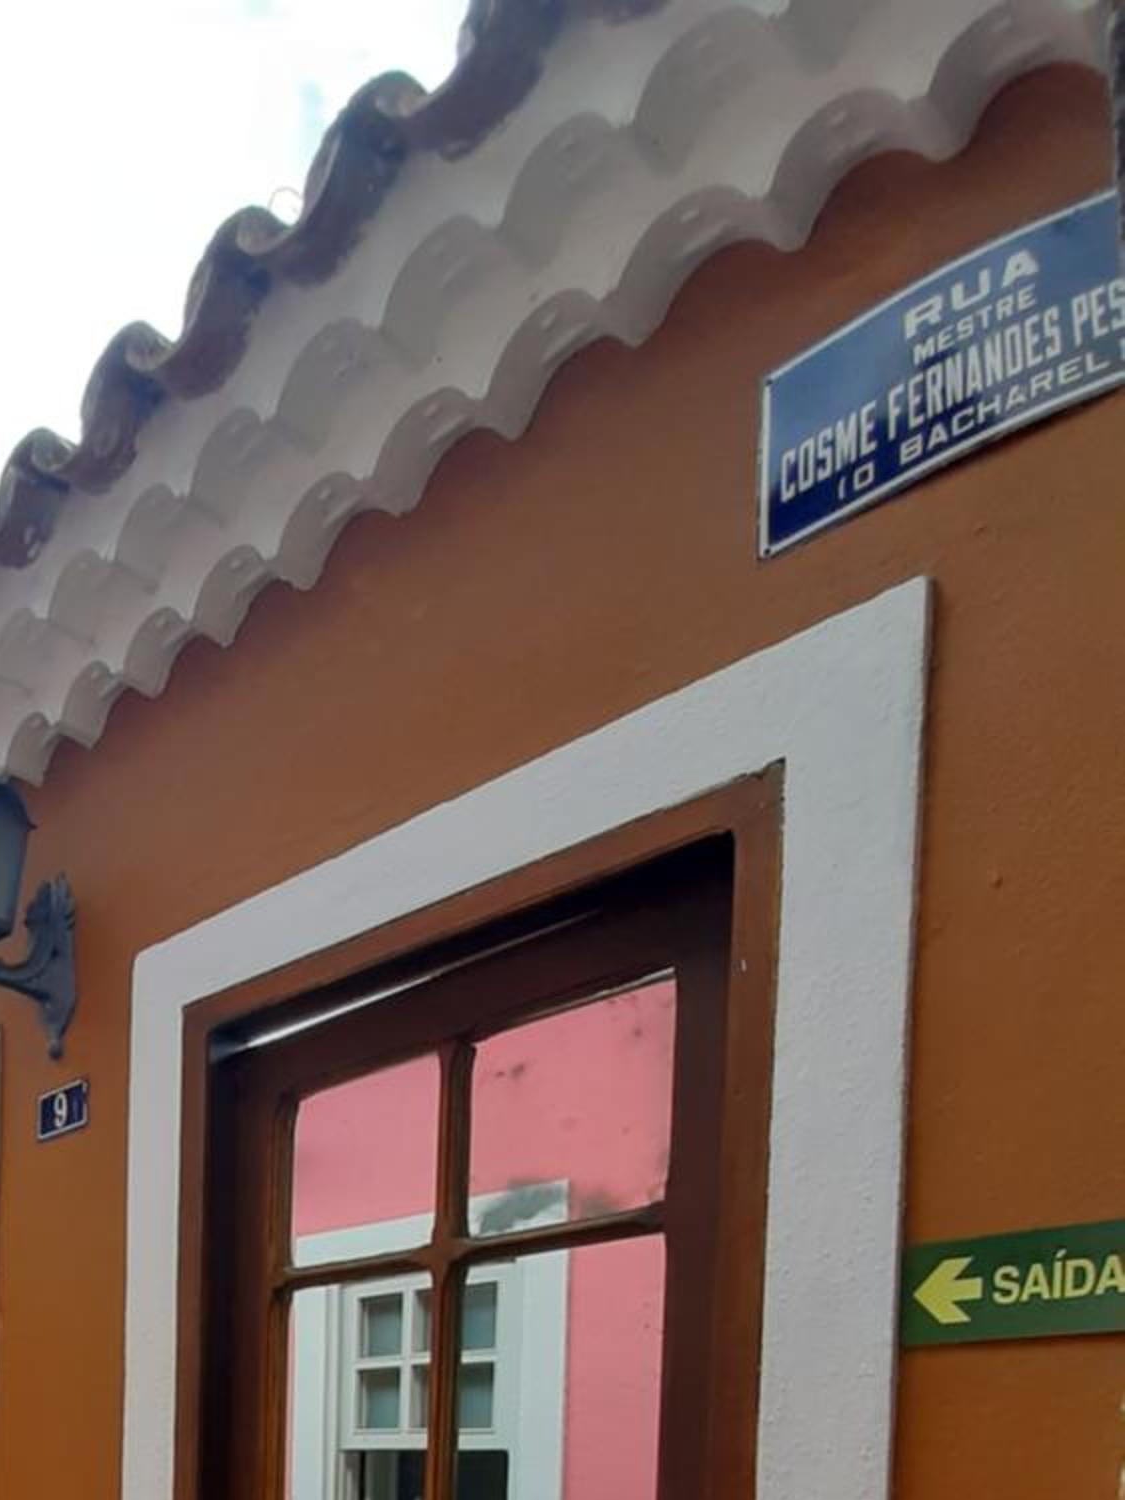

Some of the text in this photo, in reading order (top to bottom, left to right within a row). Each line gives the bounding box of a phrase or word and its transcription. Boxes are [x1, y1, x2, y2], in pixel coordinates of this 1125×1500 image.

[904, 249, 1039, 339] RUA
[913, 284, 1036, 366] MESTRE
[780, 399, 878, 503] COSME
[887, 305, 1061, 441] FERNANDES
[899, 352, 1110, 467] BACHAREL
[54, 1092, 68, 1127] 9
[992, 1248, 1125, 1305] SAÍDA
